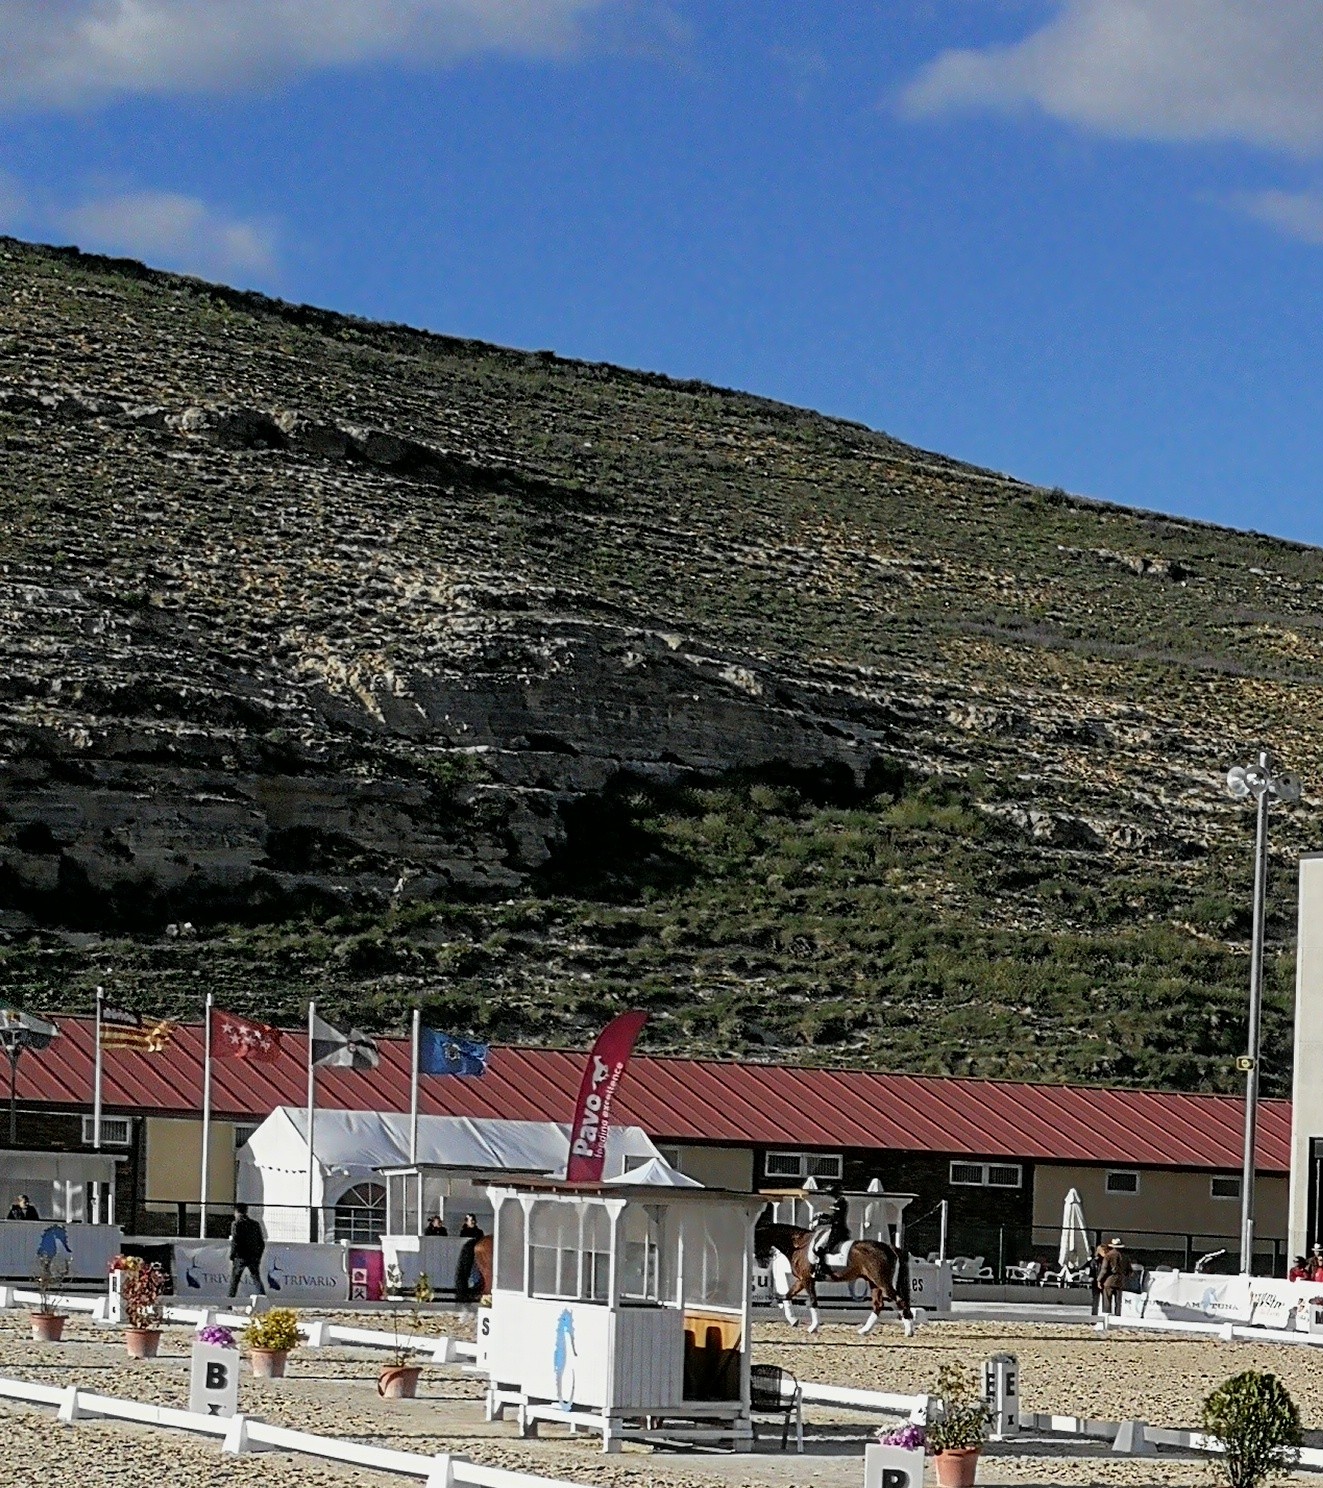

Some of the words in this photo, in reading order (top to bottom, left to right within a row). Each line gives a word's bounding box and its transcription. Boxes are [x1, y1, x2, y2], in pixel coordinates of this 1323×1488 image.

[573, 1093, 602, 1157] Pavo
[282, 1275, 337, 1288] TRIVARIS
[482, 1317, 490, 1336] S
[206, 1362, 229, 1390] B
[1006, 1372, 1015, 1396] E
